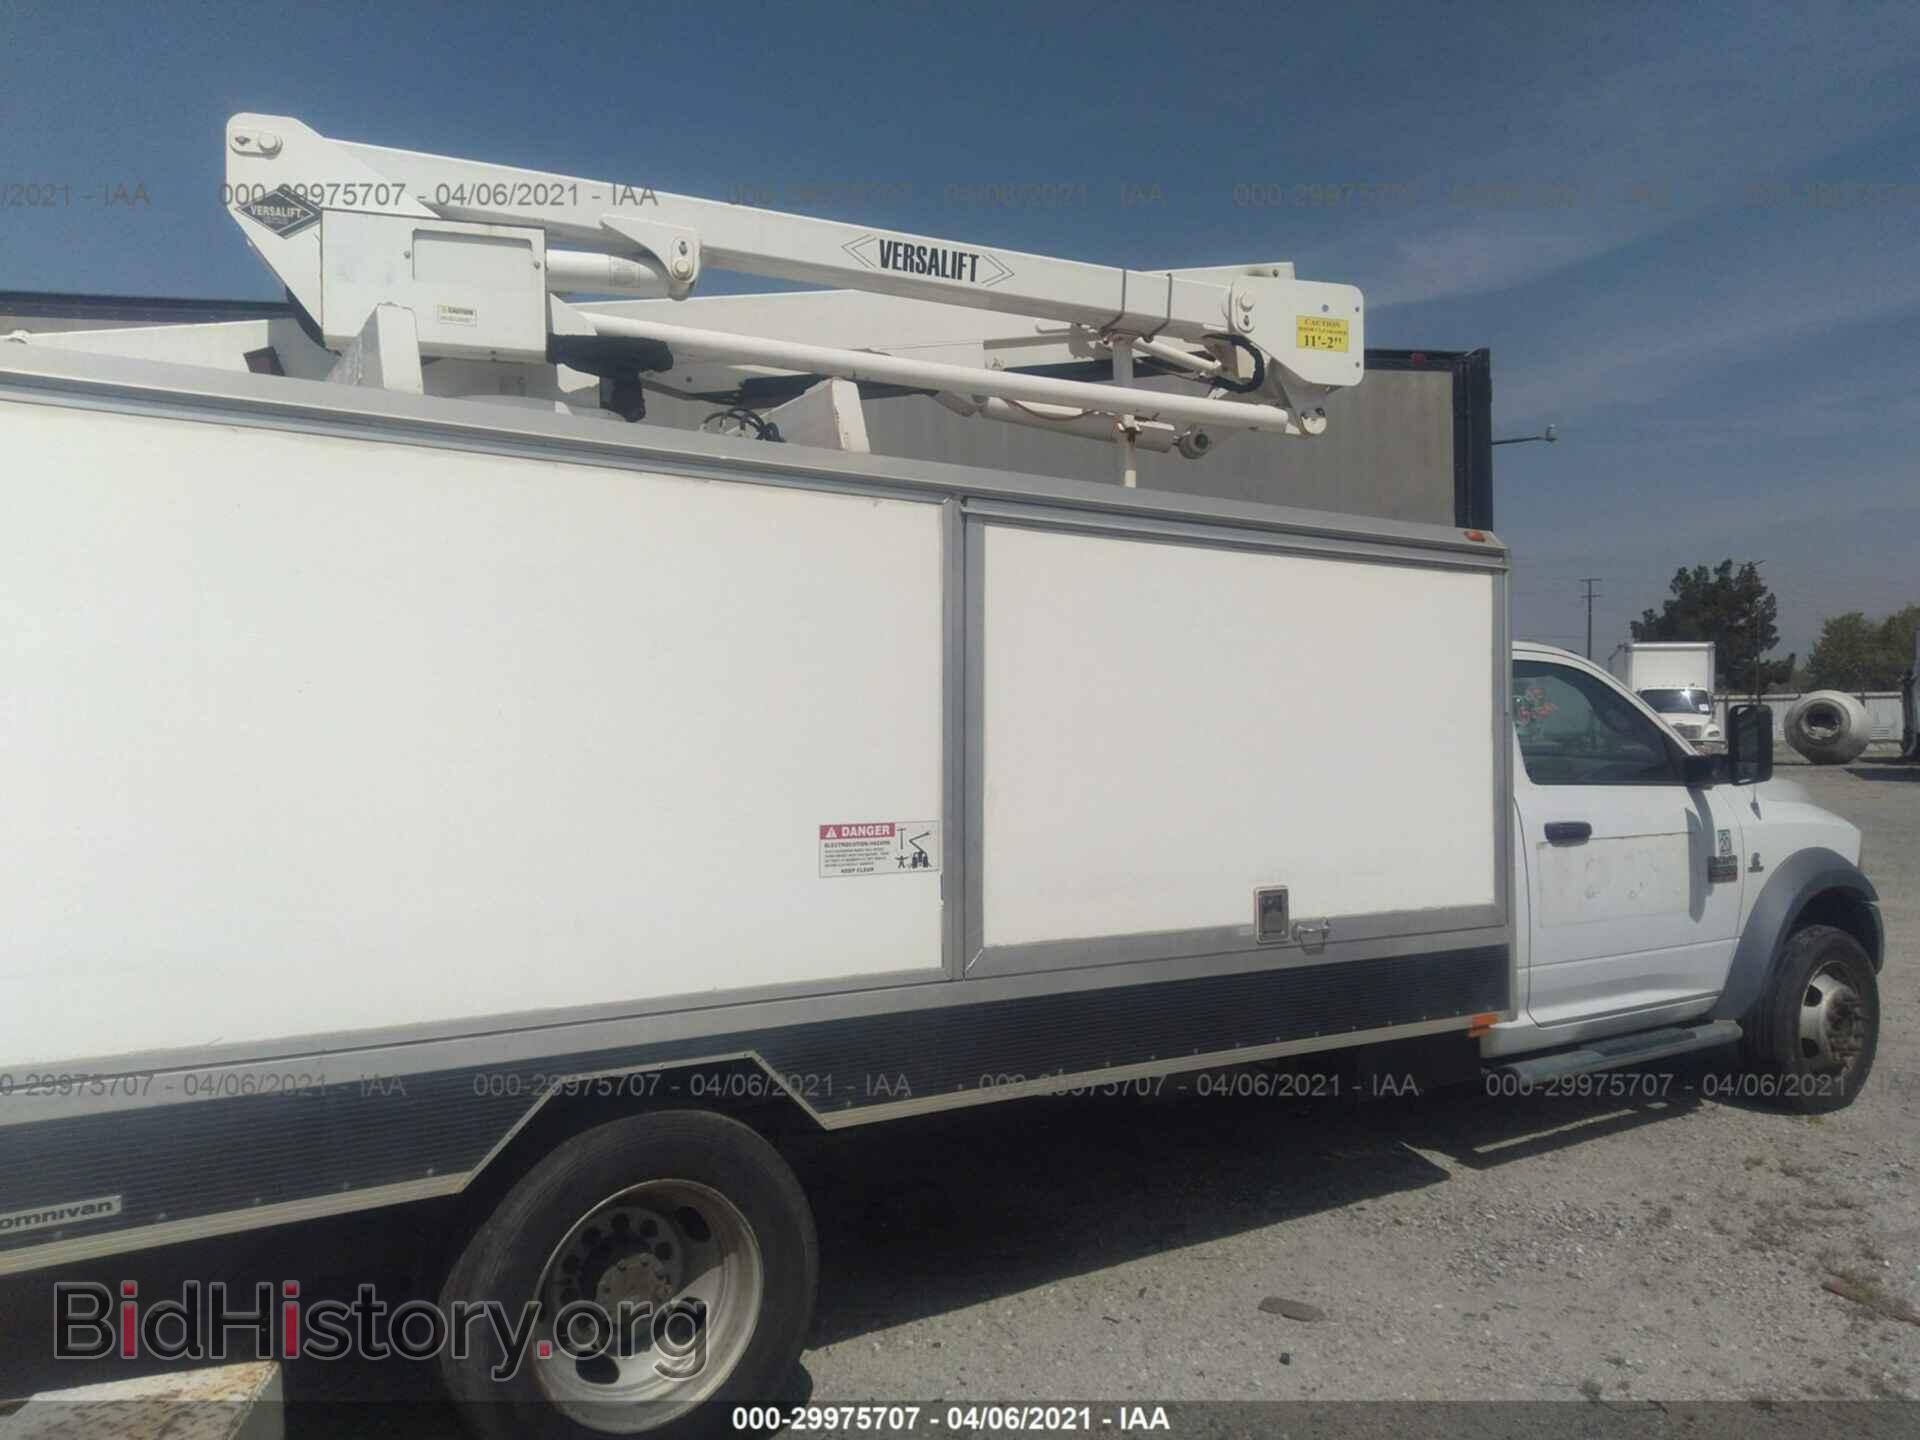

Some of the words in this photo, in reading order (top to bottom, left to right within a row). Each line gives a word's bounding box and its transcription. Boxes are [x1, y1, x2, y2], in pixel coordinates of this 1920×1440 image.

[250, 205, 302, 218] VERSALIFT
[879, 239, 979, 282] VERSALIFT
[841, 825, 891, 838] DANGER
[0, 1201, 113, 1229] omnivan
